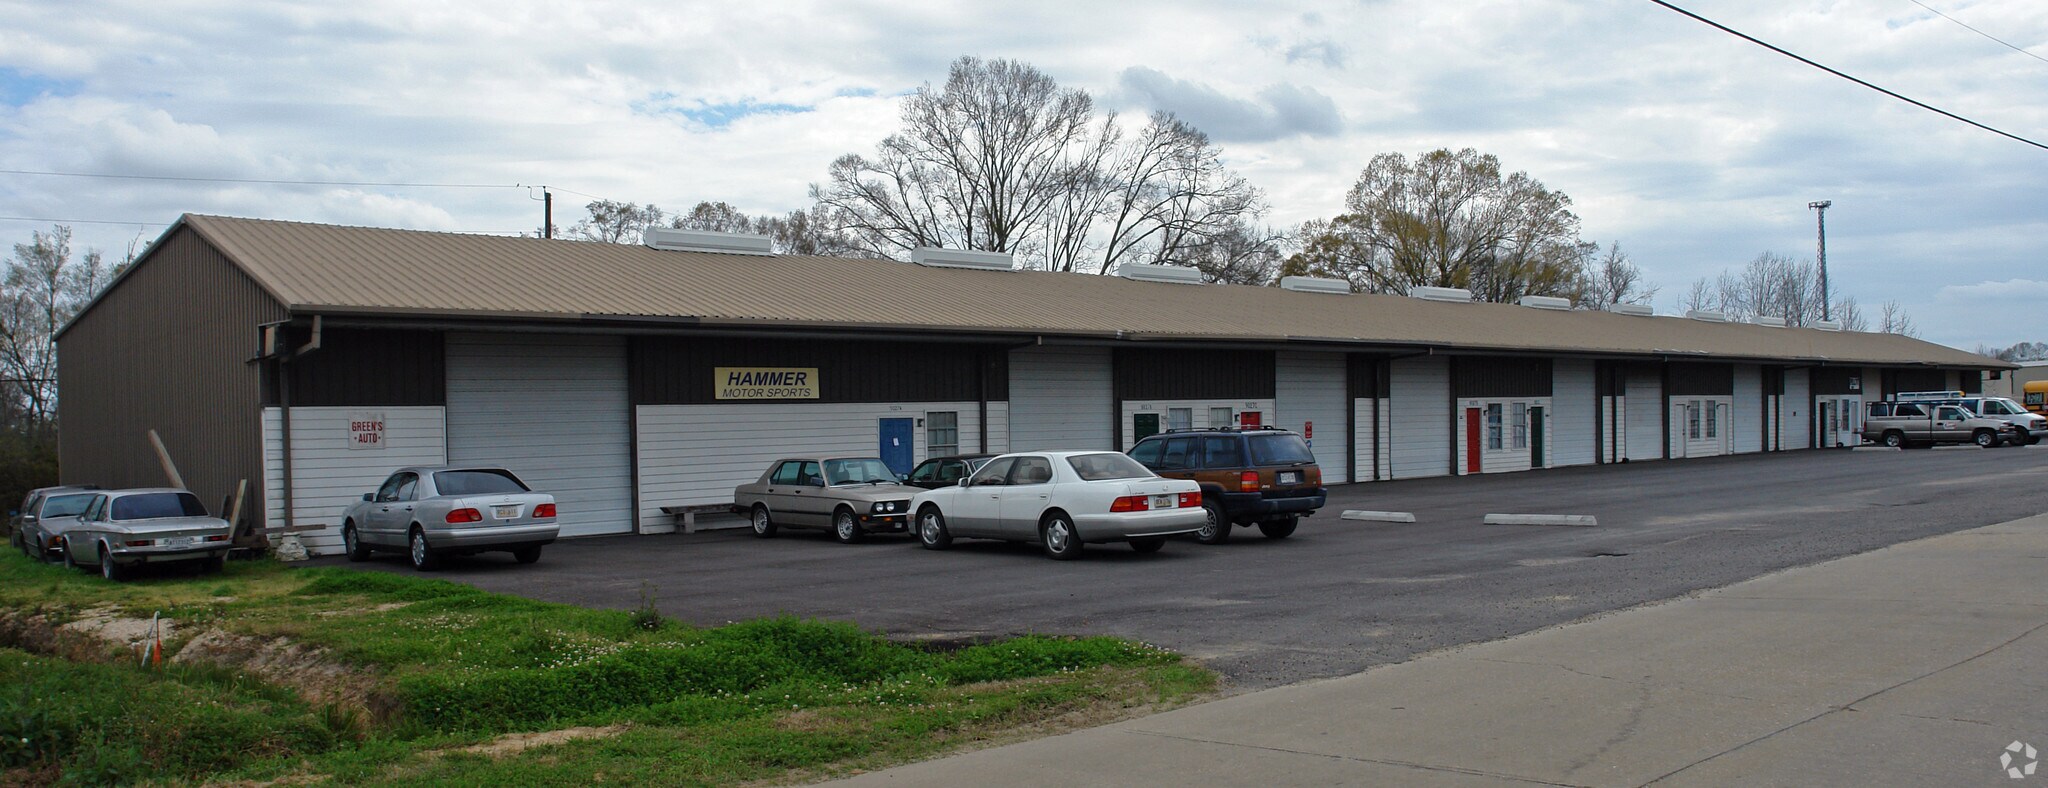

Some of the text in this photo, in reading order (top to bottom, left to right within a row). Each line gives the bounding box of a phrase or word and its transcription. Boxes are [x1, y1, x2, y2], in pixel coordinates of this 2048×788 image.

[727, 372, 807, 386] HAMMER
[722, 388, 811, 397] MOTOR SPORTS
[352, 421, 383, 431] GREEN'S
